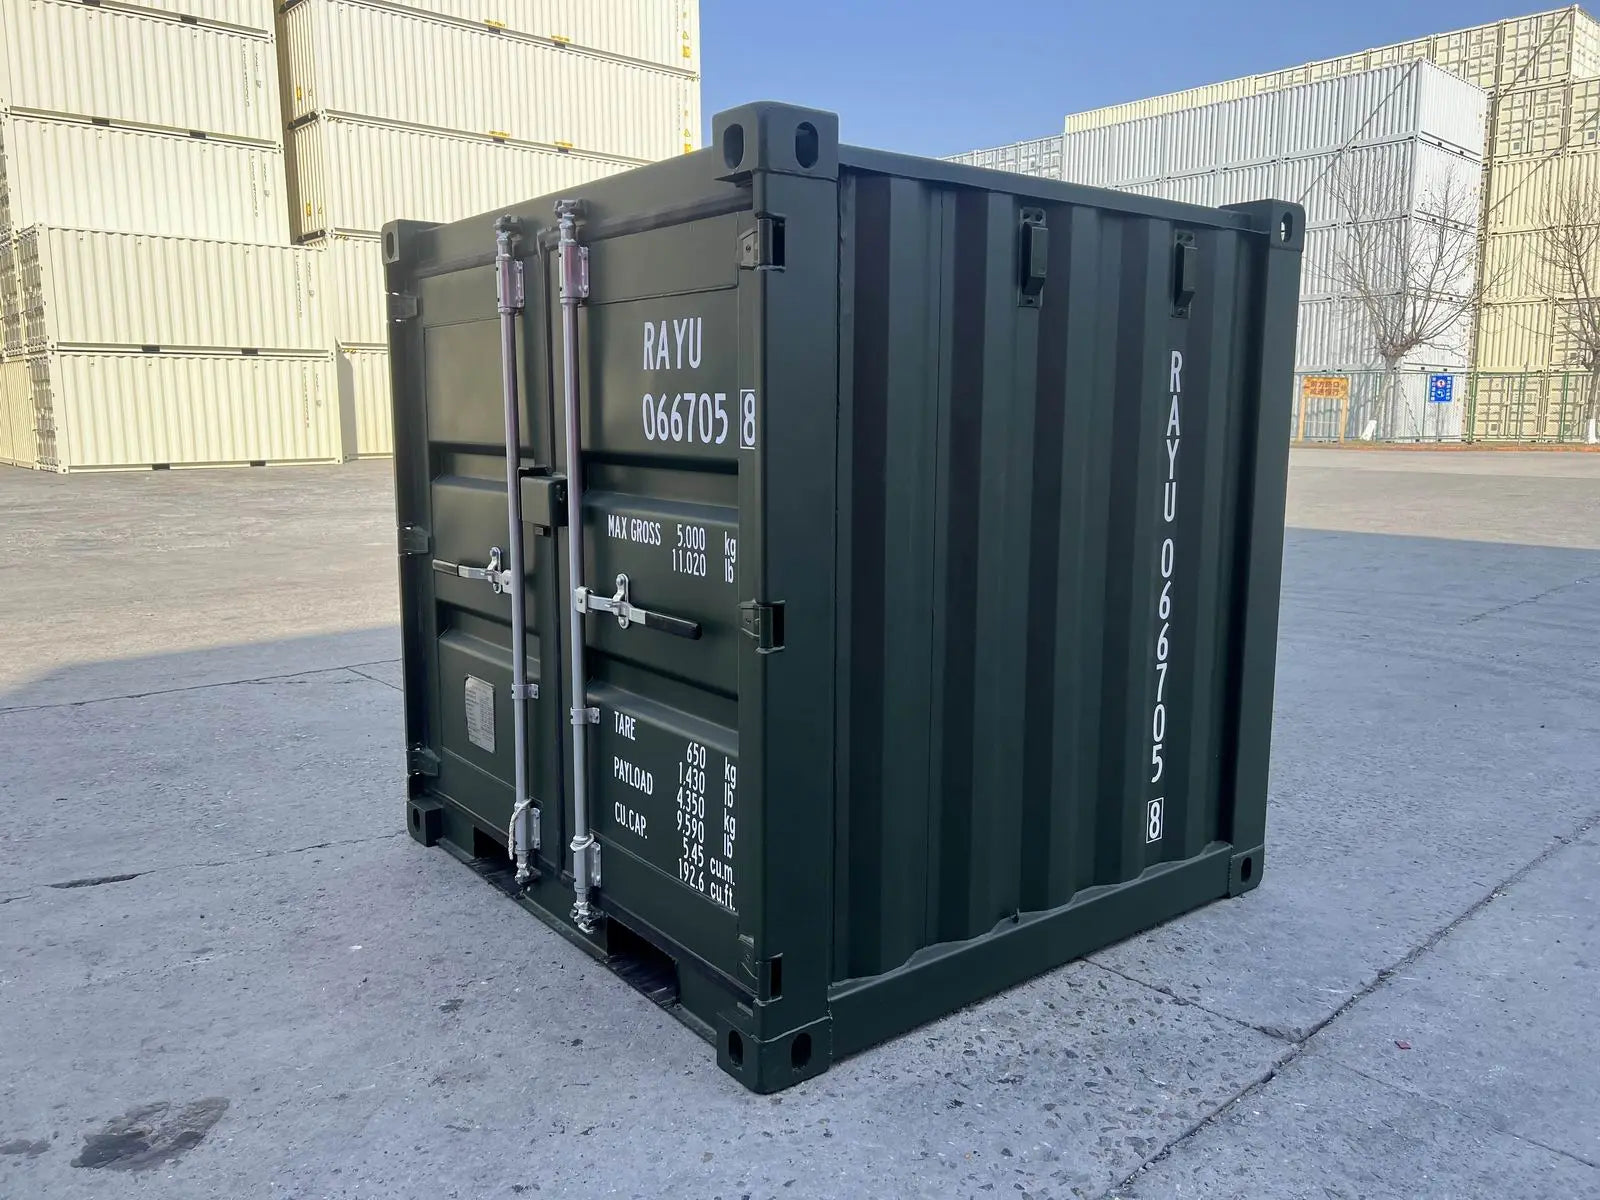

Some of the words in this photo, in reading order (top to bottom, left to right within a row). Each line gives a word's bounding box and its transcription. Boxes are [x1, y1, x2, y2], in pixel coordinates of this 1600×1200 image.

[643, 317, 702, 370] RAYU
[642, 393, 729, 445] 066705
[743, 392, 756, 446] 8
[1164, 350, 1183, 522] RAYU
[608, 514, 628, 540] MAX
[630, 518, 661, 546] GROSS
[724, 531, 737, 564] kg
[724, 558, 734, 583] lb
[1151, 538, 1174, 783] 066705
[613, 710, 636, 741] TARE
[686, 741, 706, 769] 650
[724, 756, 737, 789] kg
[613, 756, 653, 795] PAYLOAD
[676, 786, 705, 819] 4,350
[723, 808, 736, 841] kg
[678, 761, 706, 794] 1,430
[724, 782, 734, 808] lb
[614, 801, 648, 839] CU.CAP.
[682, 836, 704, 868] 5.45
[709, 857, 736, 886] cu.m.
[723, 832, 733, 859] lb
[1149, 801, 1160, 839] 8
[678, 858, 705, 893] 192.6
[709, 881, 736, 911] cu.ft.
